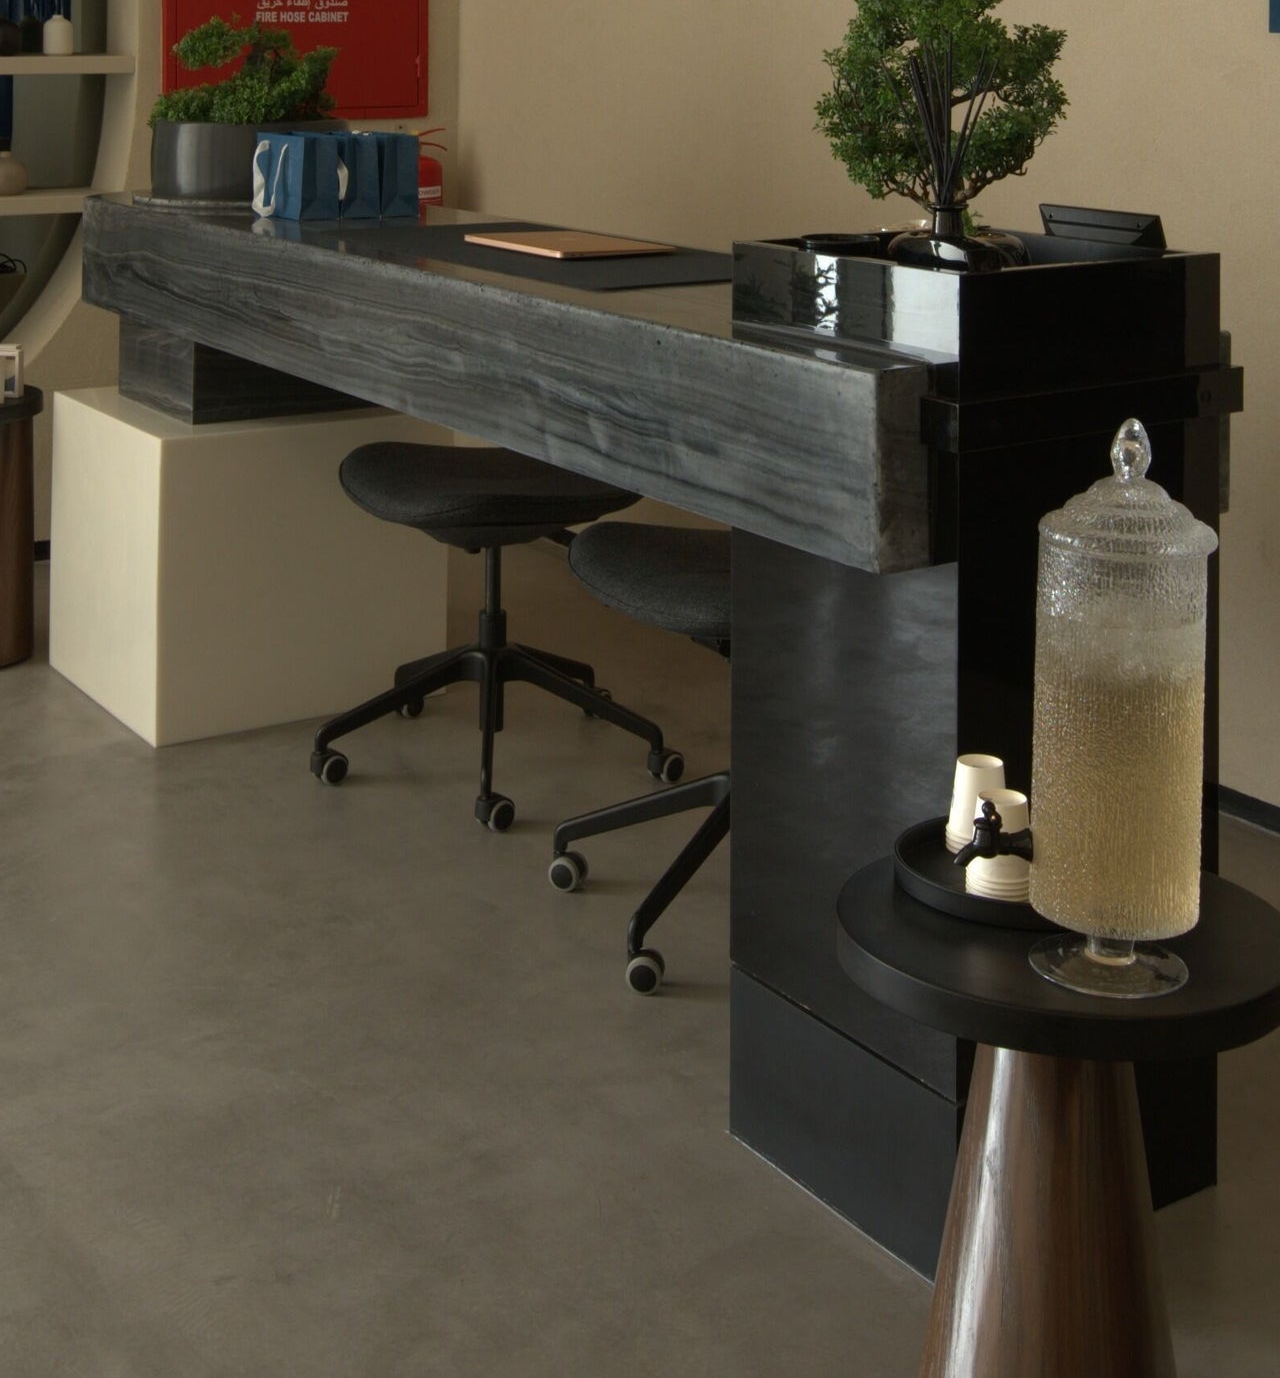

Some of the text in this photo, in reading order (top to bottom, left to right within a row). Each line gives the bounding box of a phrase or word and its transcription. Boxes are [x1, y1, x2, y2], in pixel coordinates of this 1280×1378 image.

[256, 11, 349, 23] FIRE HOSE CABINET
